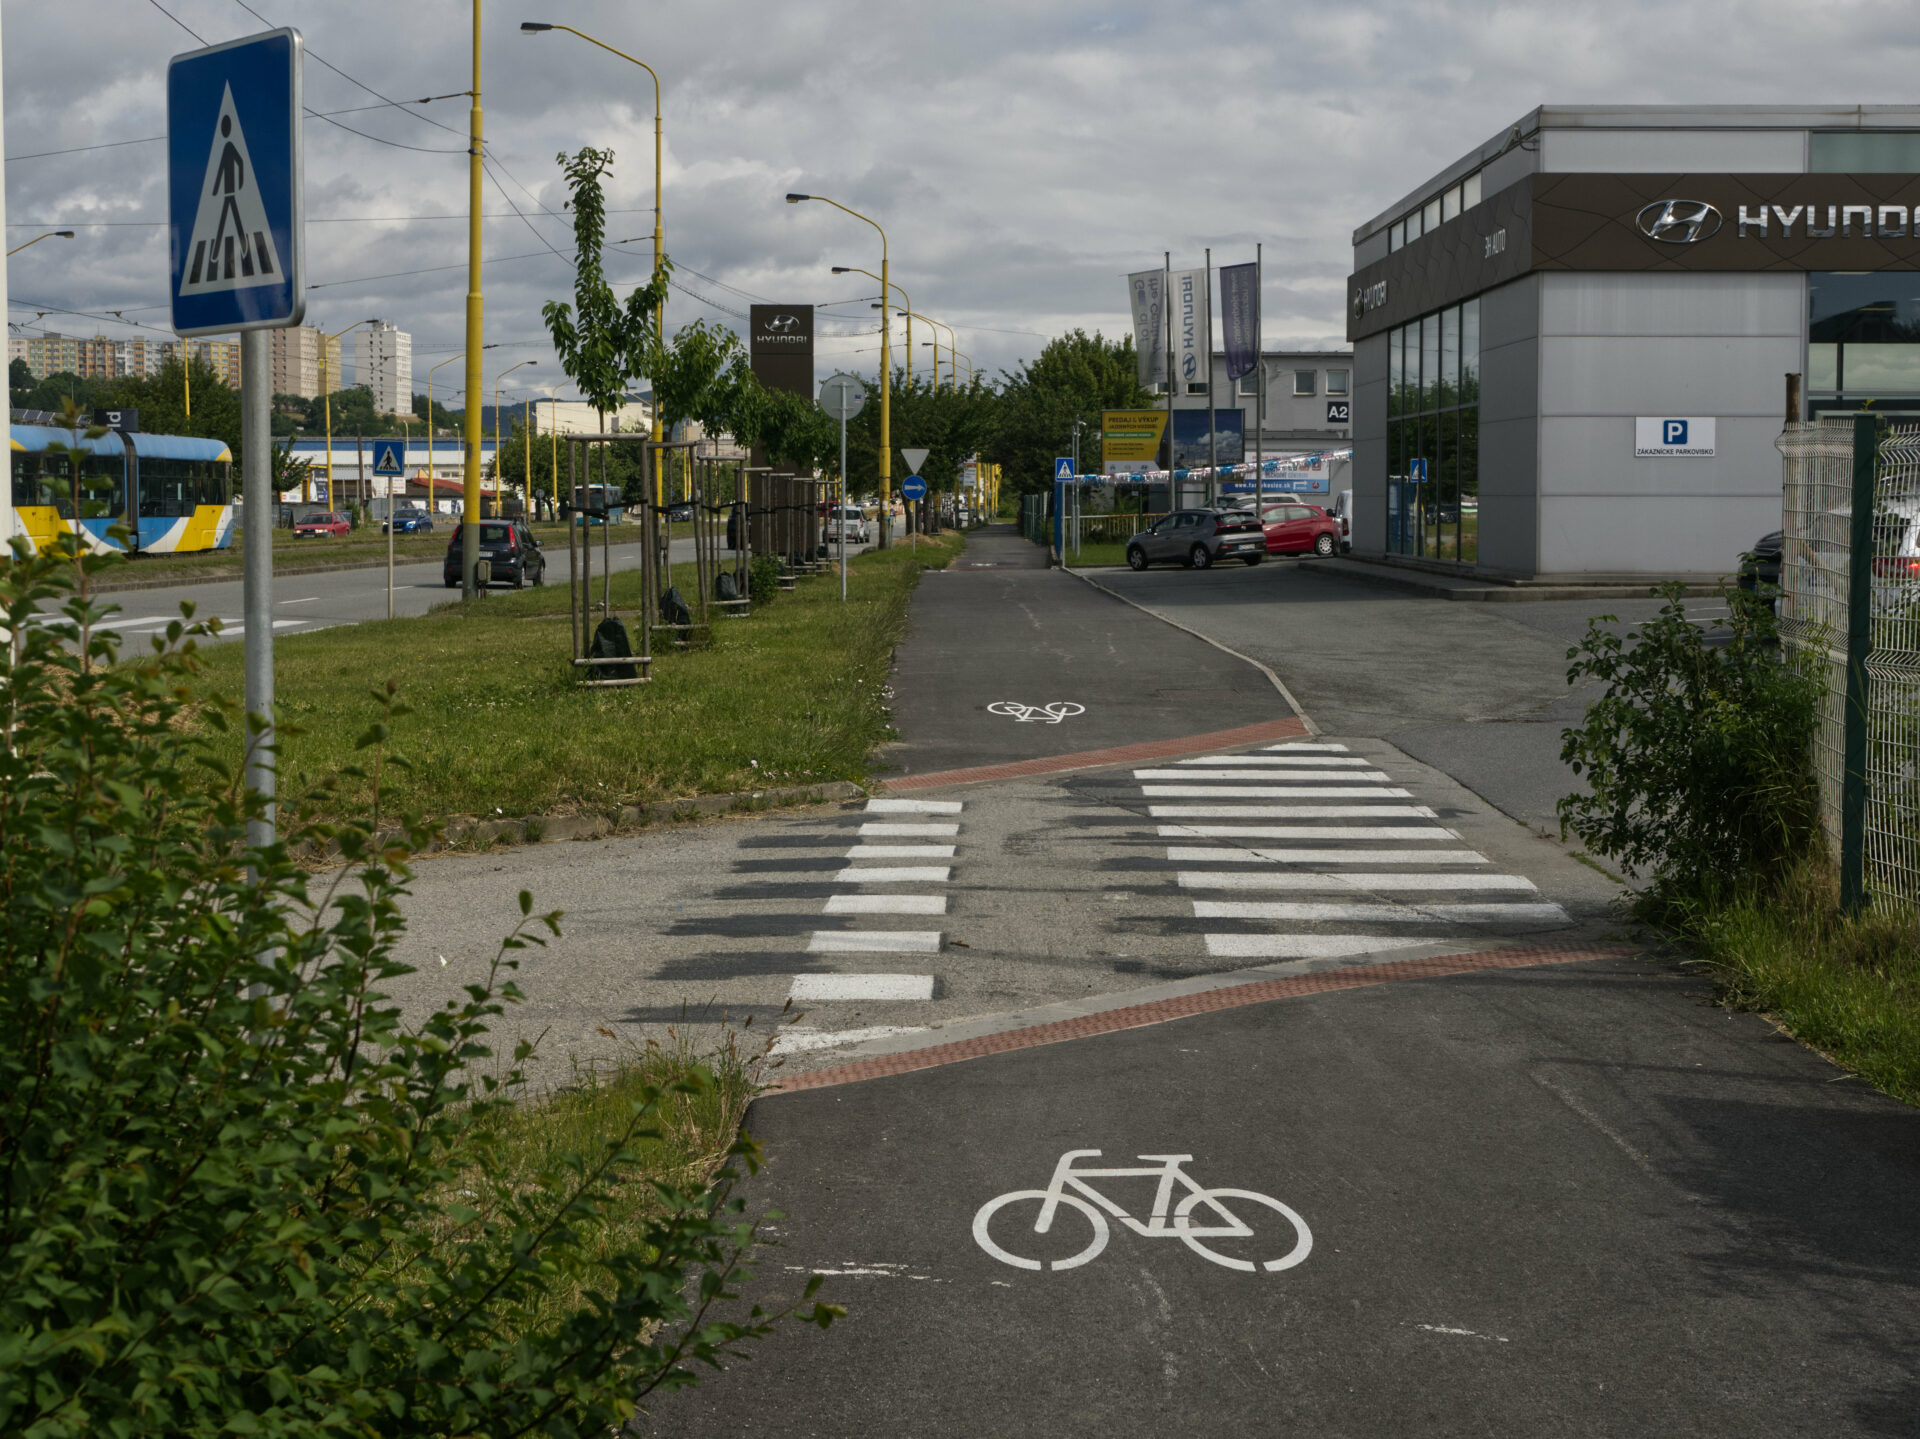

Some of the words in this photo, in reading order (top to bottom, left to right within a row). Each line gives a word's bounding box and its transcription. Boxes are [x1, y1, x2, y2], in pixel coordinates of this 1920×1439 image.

[1738, 205, 1920, 238] HYUND
[756, 335, 808, 344] HYUNDAI
[1328, 405, 1348, 419] A2
[1668, 422, 1683, 442] P
[1637, 447, 1674, 455] ZÁKAZNÍCKE
